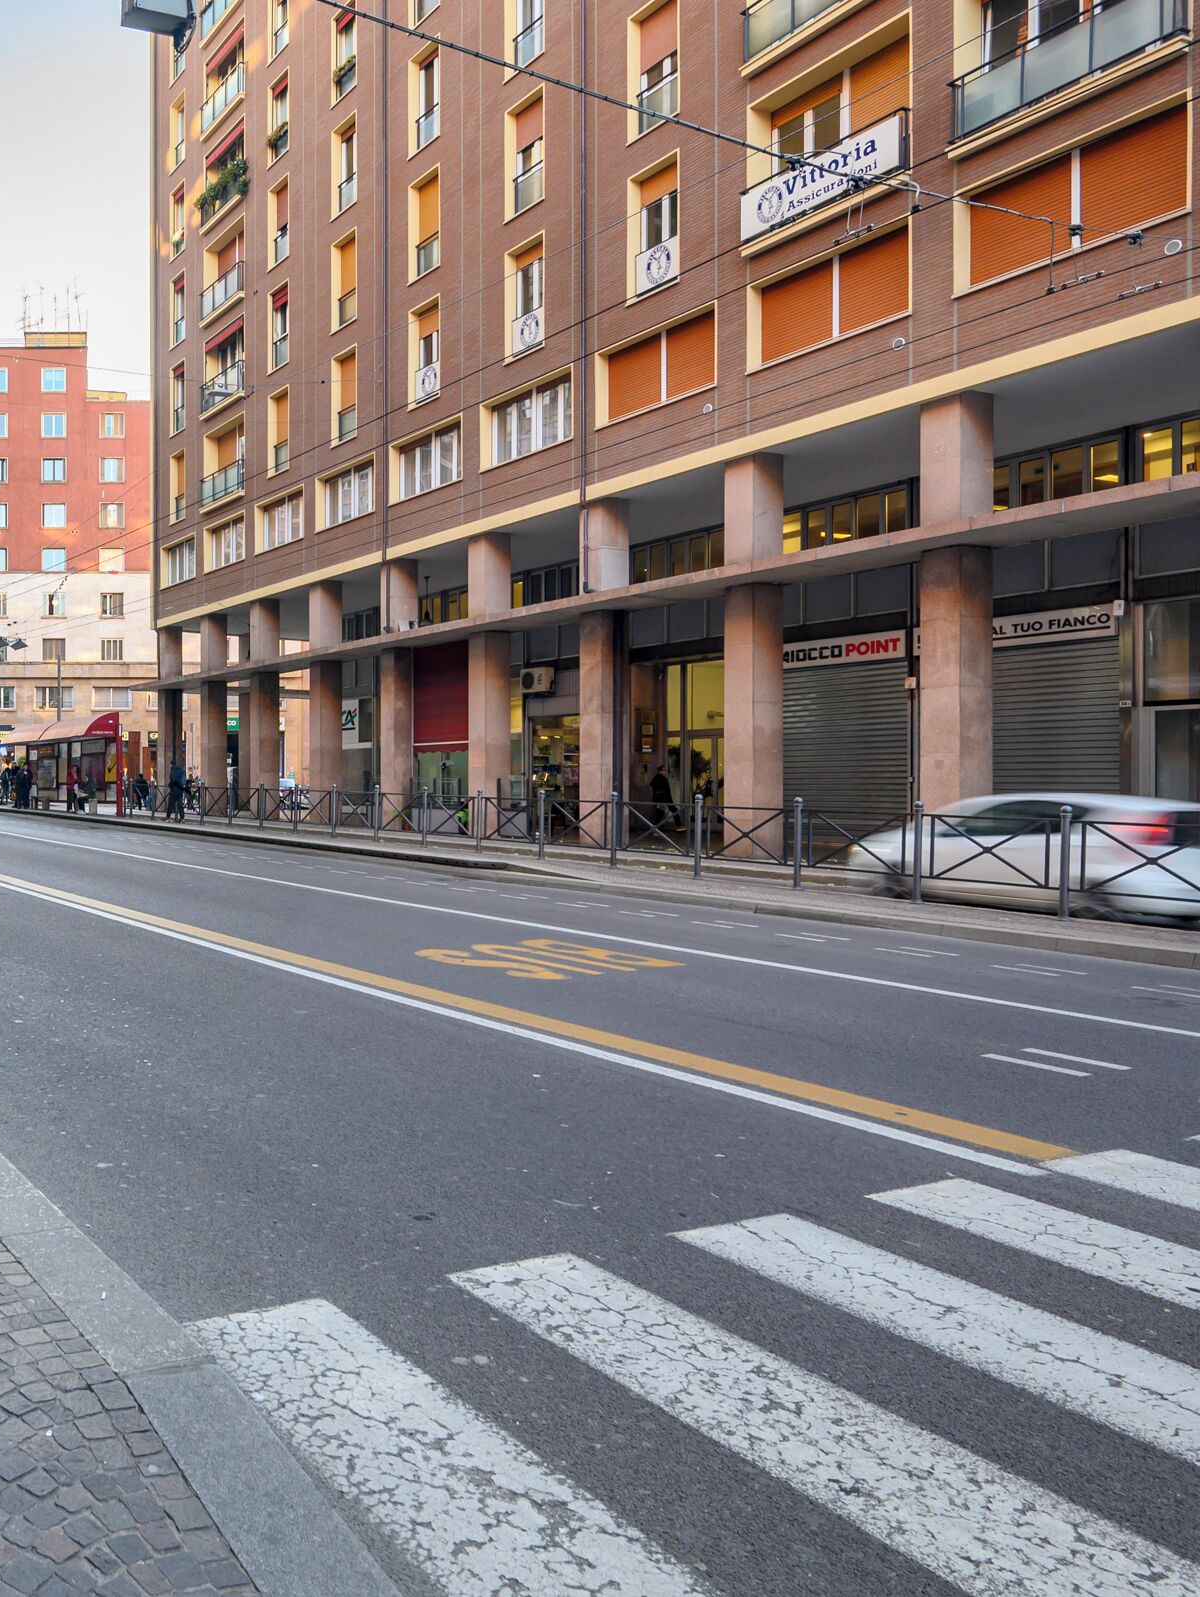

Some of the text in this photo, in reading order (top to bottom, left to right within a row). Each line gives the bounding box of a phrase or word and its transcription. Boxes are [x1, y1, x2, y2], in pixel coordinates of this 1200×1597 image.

[782, 138, 877, 195] Vittoria
[1011, 621, 1043, 634] TUO
[1048, 613, 1111, 630] FIANCO
[845, 637, 901, 657] POINT
